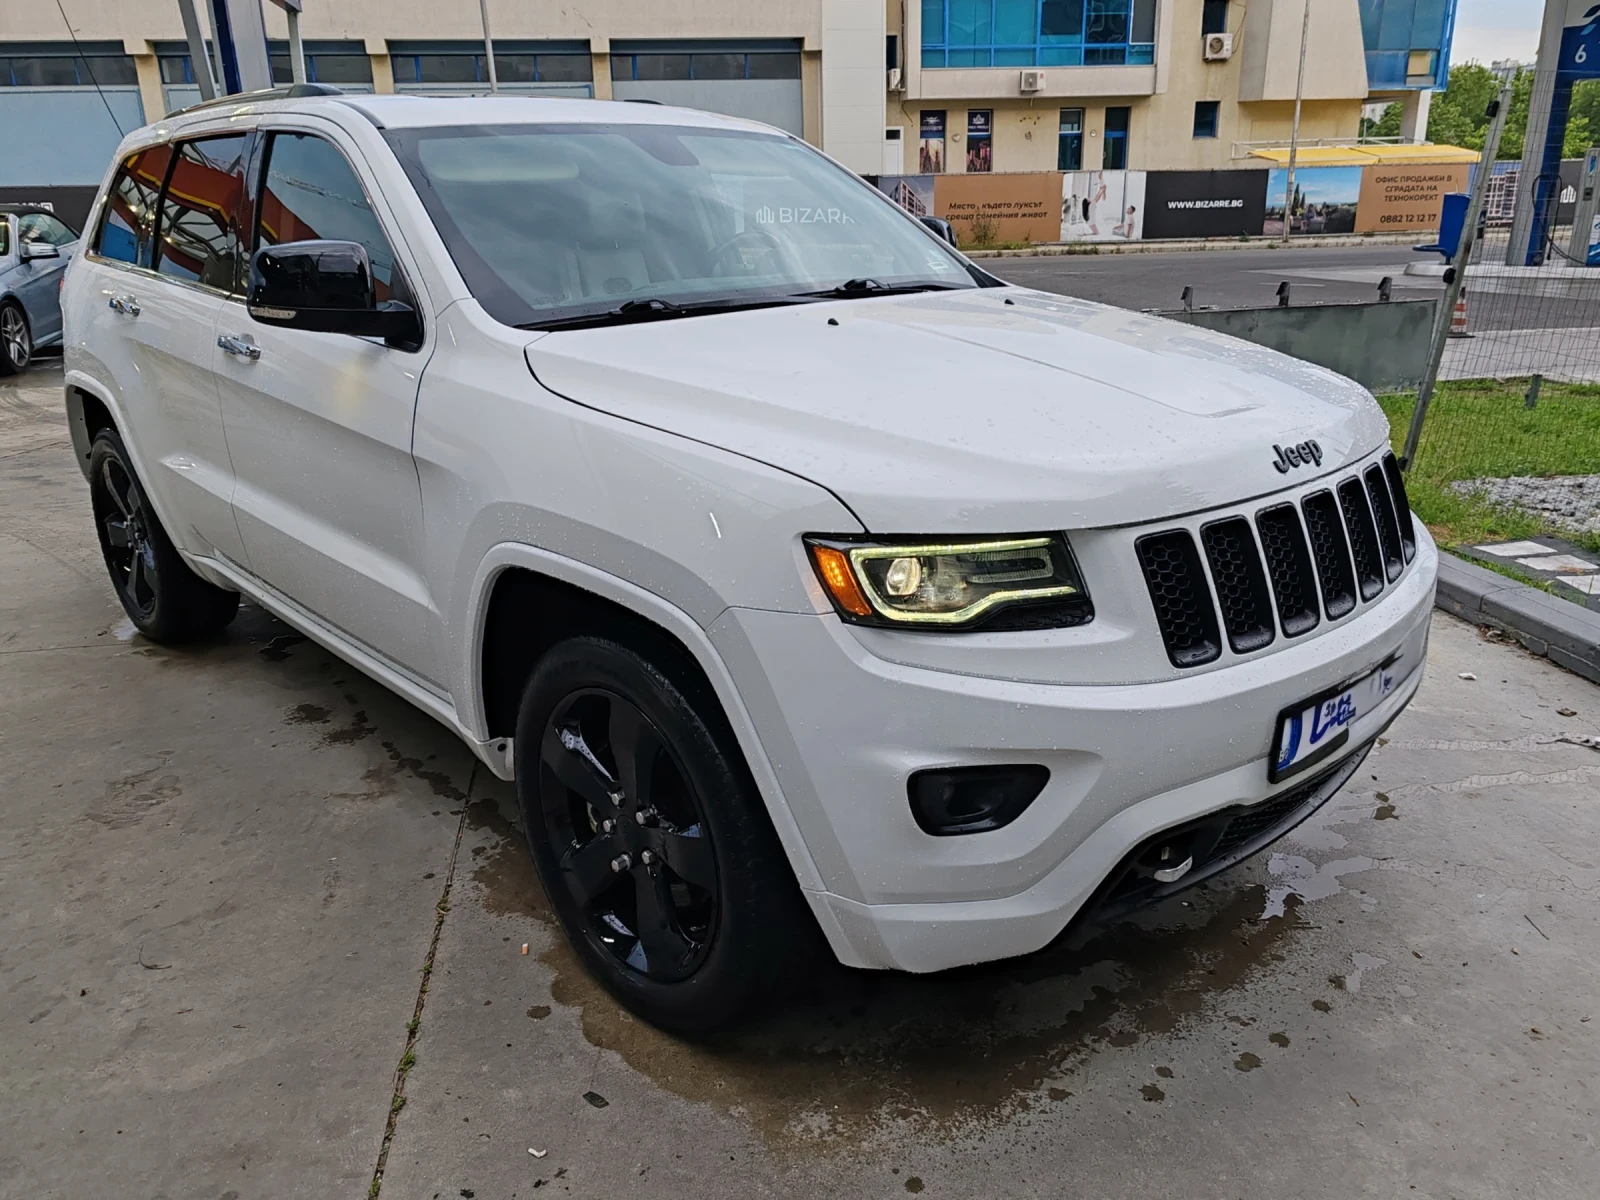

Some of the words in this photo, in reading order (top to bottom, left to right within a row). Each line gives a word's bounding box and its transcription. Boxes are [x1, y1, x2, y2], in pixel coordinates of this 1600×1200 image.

[1574, 44, 1587, 64] 6
[1400, 174, 1445, 182] ПРОДАЖБИ
[1384, 194, 1438, 202] ТЕХНОКОРЕКТ
[1013, 201, 1043, 209] луксът
[1167, 200, 1244, 209] WWW.BIZARRE.BG
[1380, 215, 1403, 223] 0882
[1405, 214, 1414, 222] 12
[1416, 214, 1426, 222] 12
[1428, 214, 1437, 222] 17
[1272, 439, 1323, 474] Jeep
